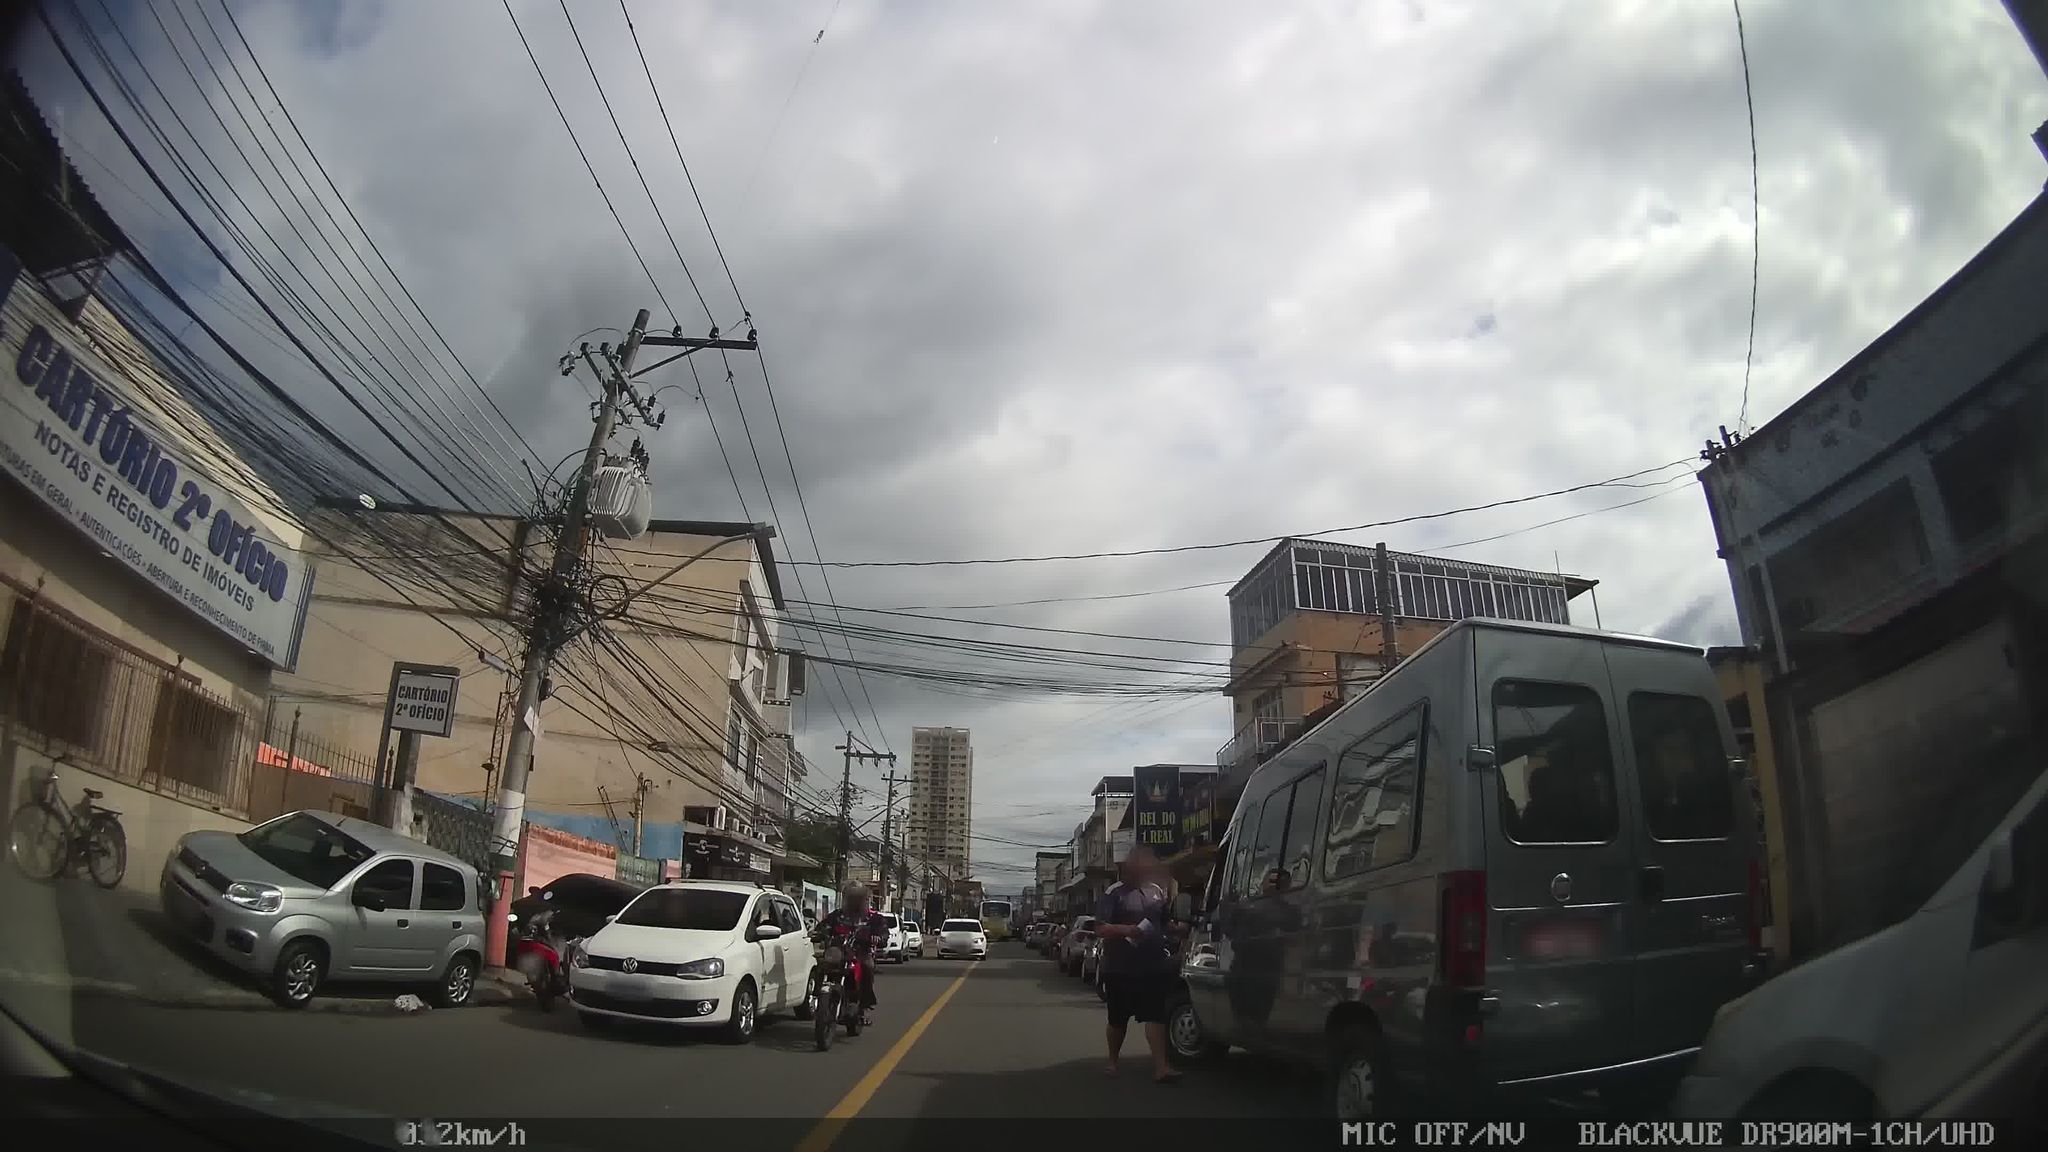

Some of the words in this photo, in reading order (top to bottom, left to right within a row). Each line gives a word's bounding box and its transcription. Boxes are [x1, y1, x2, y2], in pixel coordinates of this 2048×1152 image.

[17, 325, 178, 509] CARTÓRIO
[208, 508, 289, 602] OFÍCIO
[34, 420, 91, 482] NOTAS
[92, 473, 106, 495] E
[106, 484, 180, 555] REGISTRO
[182, 545, 202, 572] DE
[202, 562, 255, 612] IMÓVEIS
[46, 483, 74, 515] GERAL
[146, 562, 183, 596] ABERTURA
[398, 686, 448, 703] CARTÓRIO
[409, 703, 445, 721] OFÍCIO
[1139, 811, 1156, 826] REI
[1162, 811, 1176, 826] DO
[1150, 829, 1174, 844] REAL
